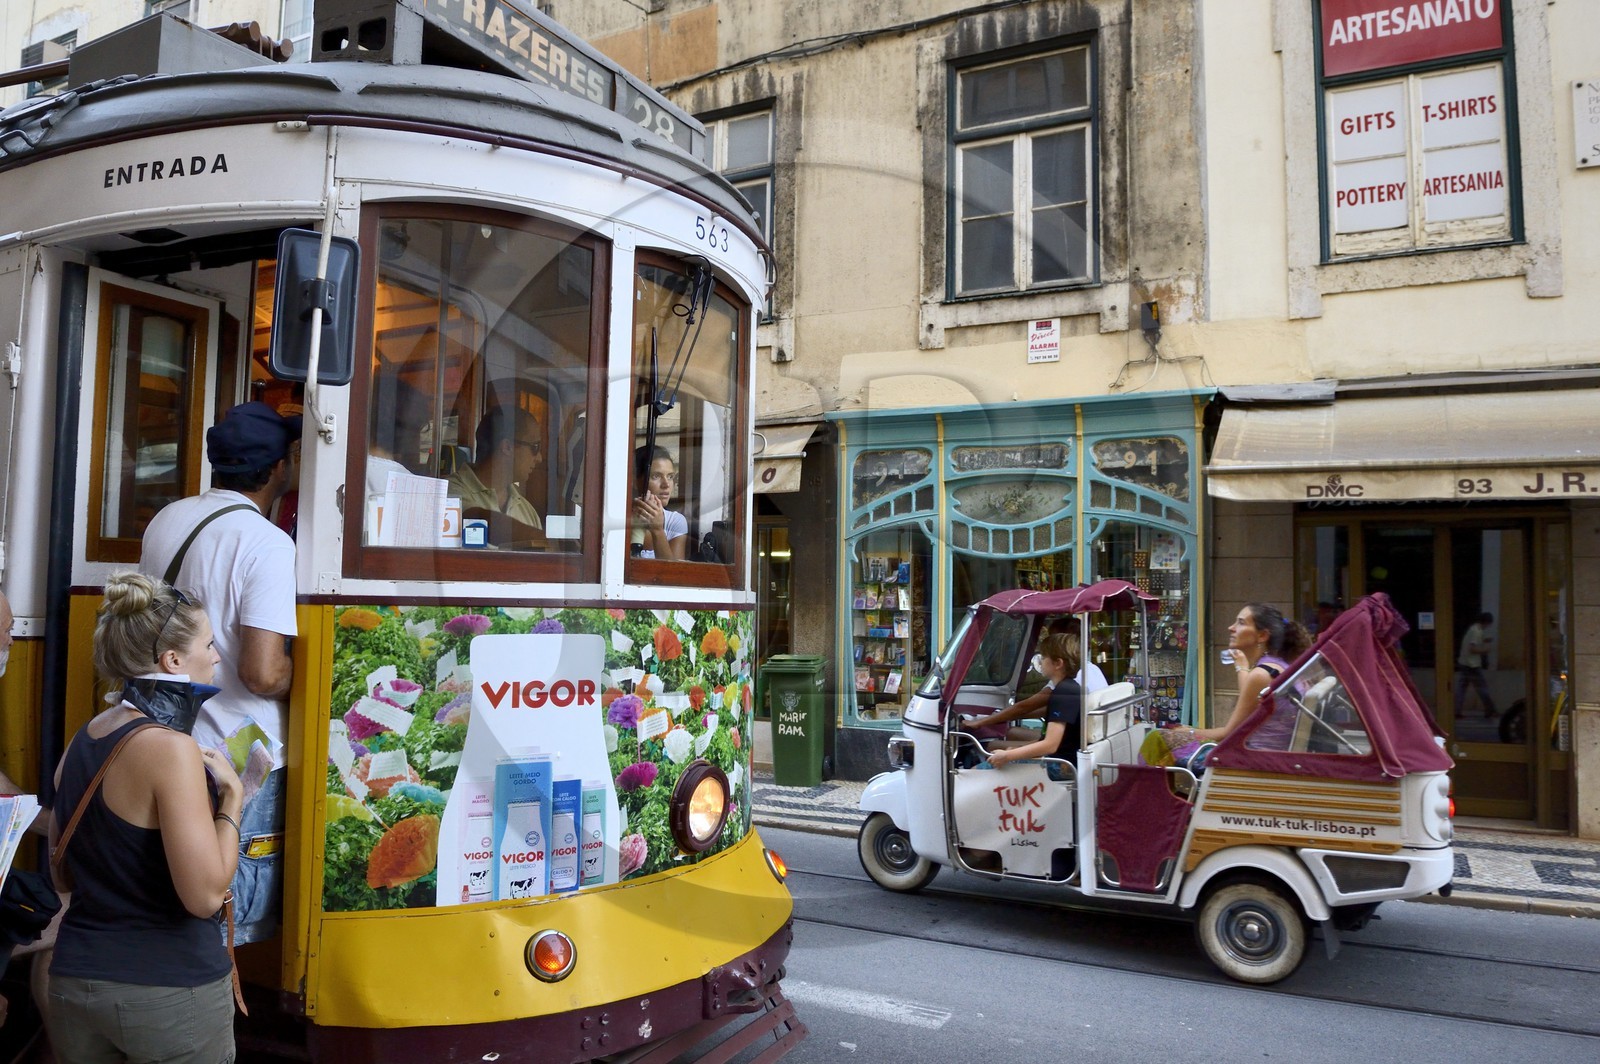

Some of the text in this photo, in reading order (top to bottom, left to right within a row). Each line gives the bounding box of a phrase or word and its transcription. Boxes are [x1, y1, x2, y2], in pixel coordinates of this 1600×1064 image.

[1329, 0, 1495, 46] ARTESANATO
[436, 0, 605, 106] RAZERES
[1422, 95, 1497, 122] T-SHIRTS
[1340, 111, 1396, 136] GIFTS
[104, 153, 228, 188] ENTRADA
[1423, 170, 1504, 196] ARTESANIA
[1336, 182, 1407, 208] POTTERY
[695, 215, 729, 253] 563
[1124, 450, 1157, 476] 91
[1306, 484, 1364, 498] DMC
[1458, 478, 1493, 494] 93
[480, 679, 596, 710] VIGOR
[1221, 815, 1376, 838] www.tuk-tuk-lisboa.pt
[502, 850, 544, 864] VIGOR
[581, 841, 603, 850] VIGOR
